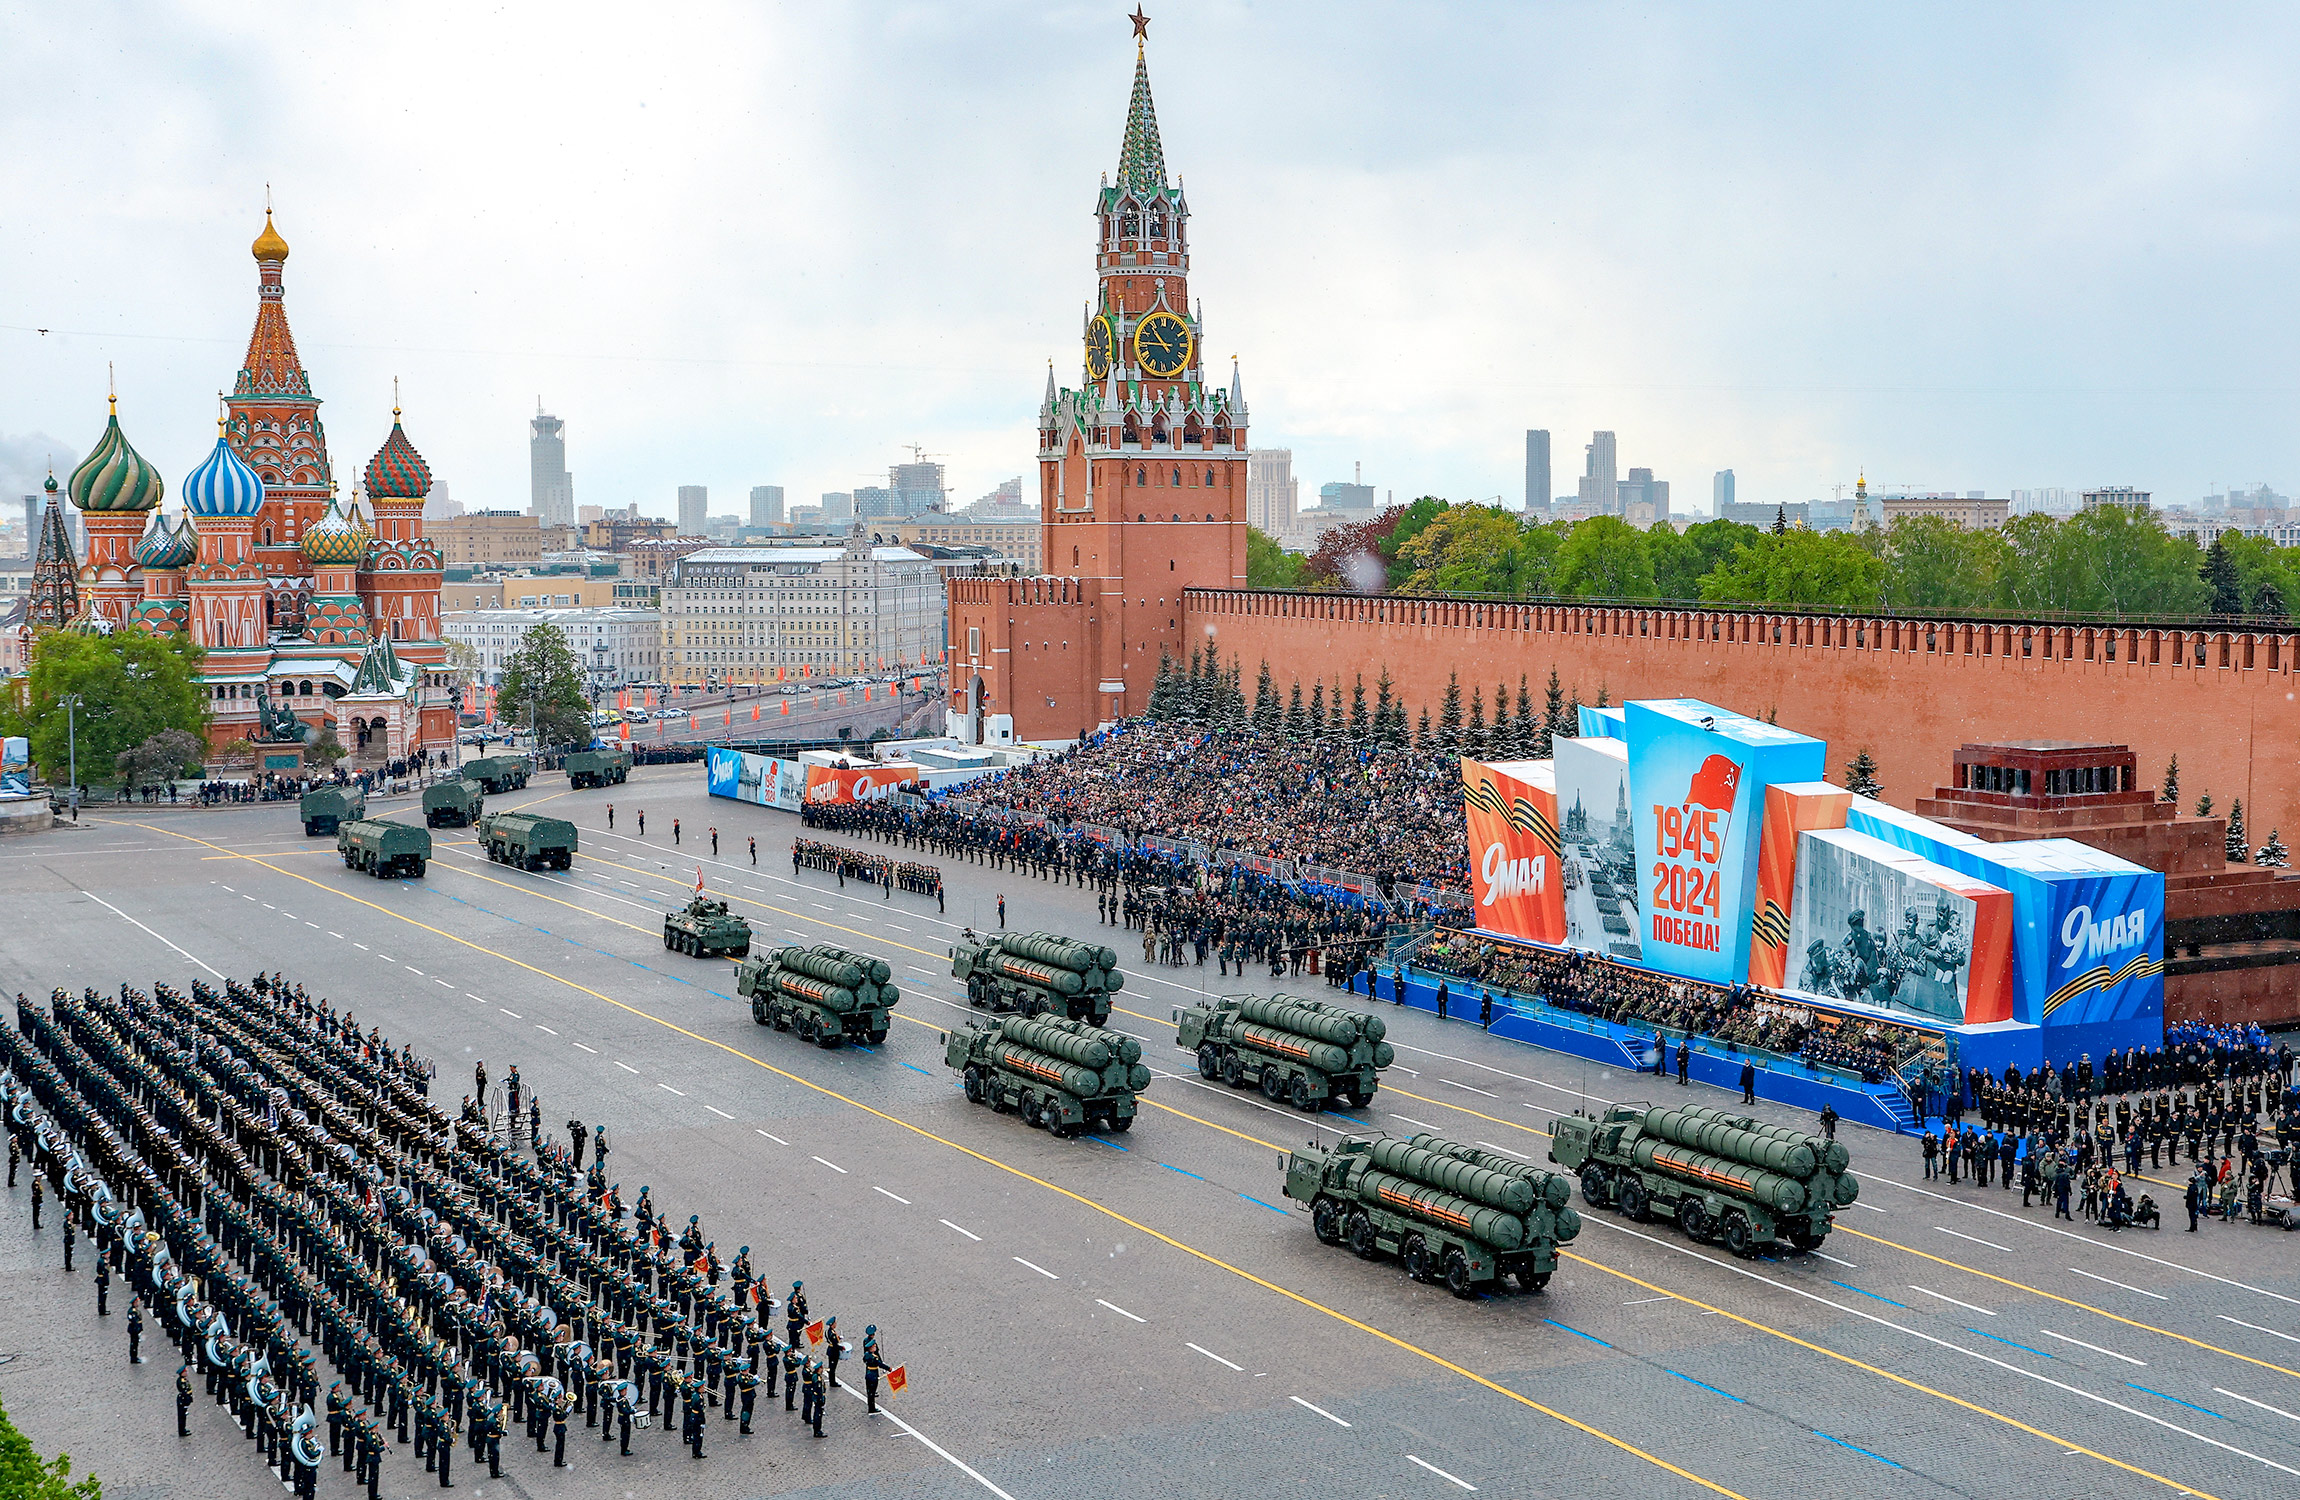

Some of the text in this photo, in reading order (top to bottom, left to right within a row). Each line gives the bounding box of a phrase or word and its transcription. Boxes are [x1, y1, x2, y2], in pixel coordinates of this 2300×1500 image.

[1653, 804, 1720, 864] 1945
[1482, 842, 1546, 906] 9 МАЯ
[1653, 862, 1720, 919] 2024
[1653, 914, 1720, 953] ПОБЕДА!
[2061, 905, 2145, 968] 9 МАЯ
